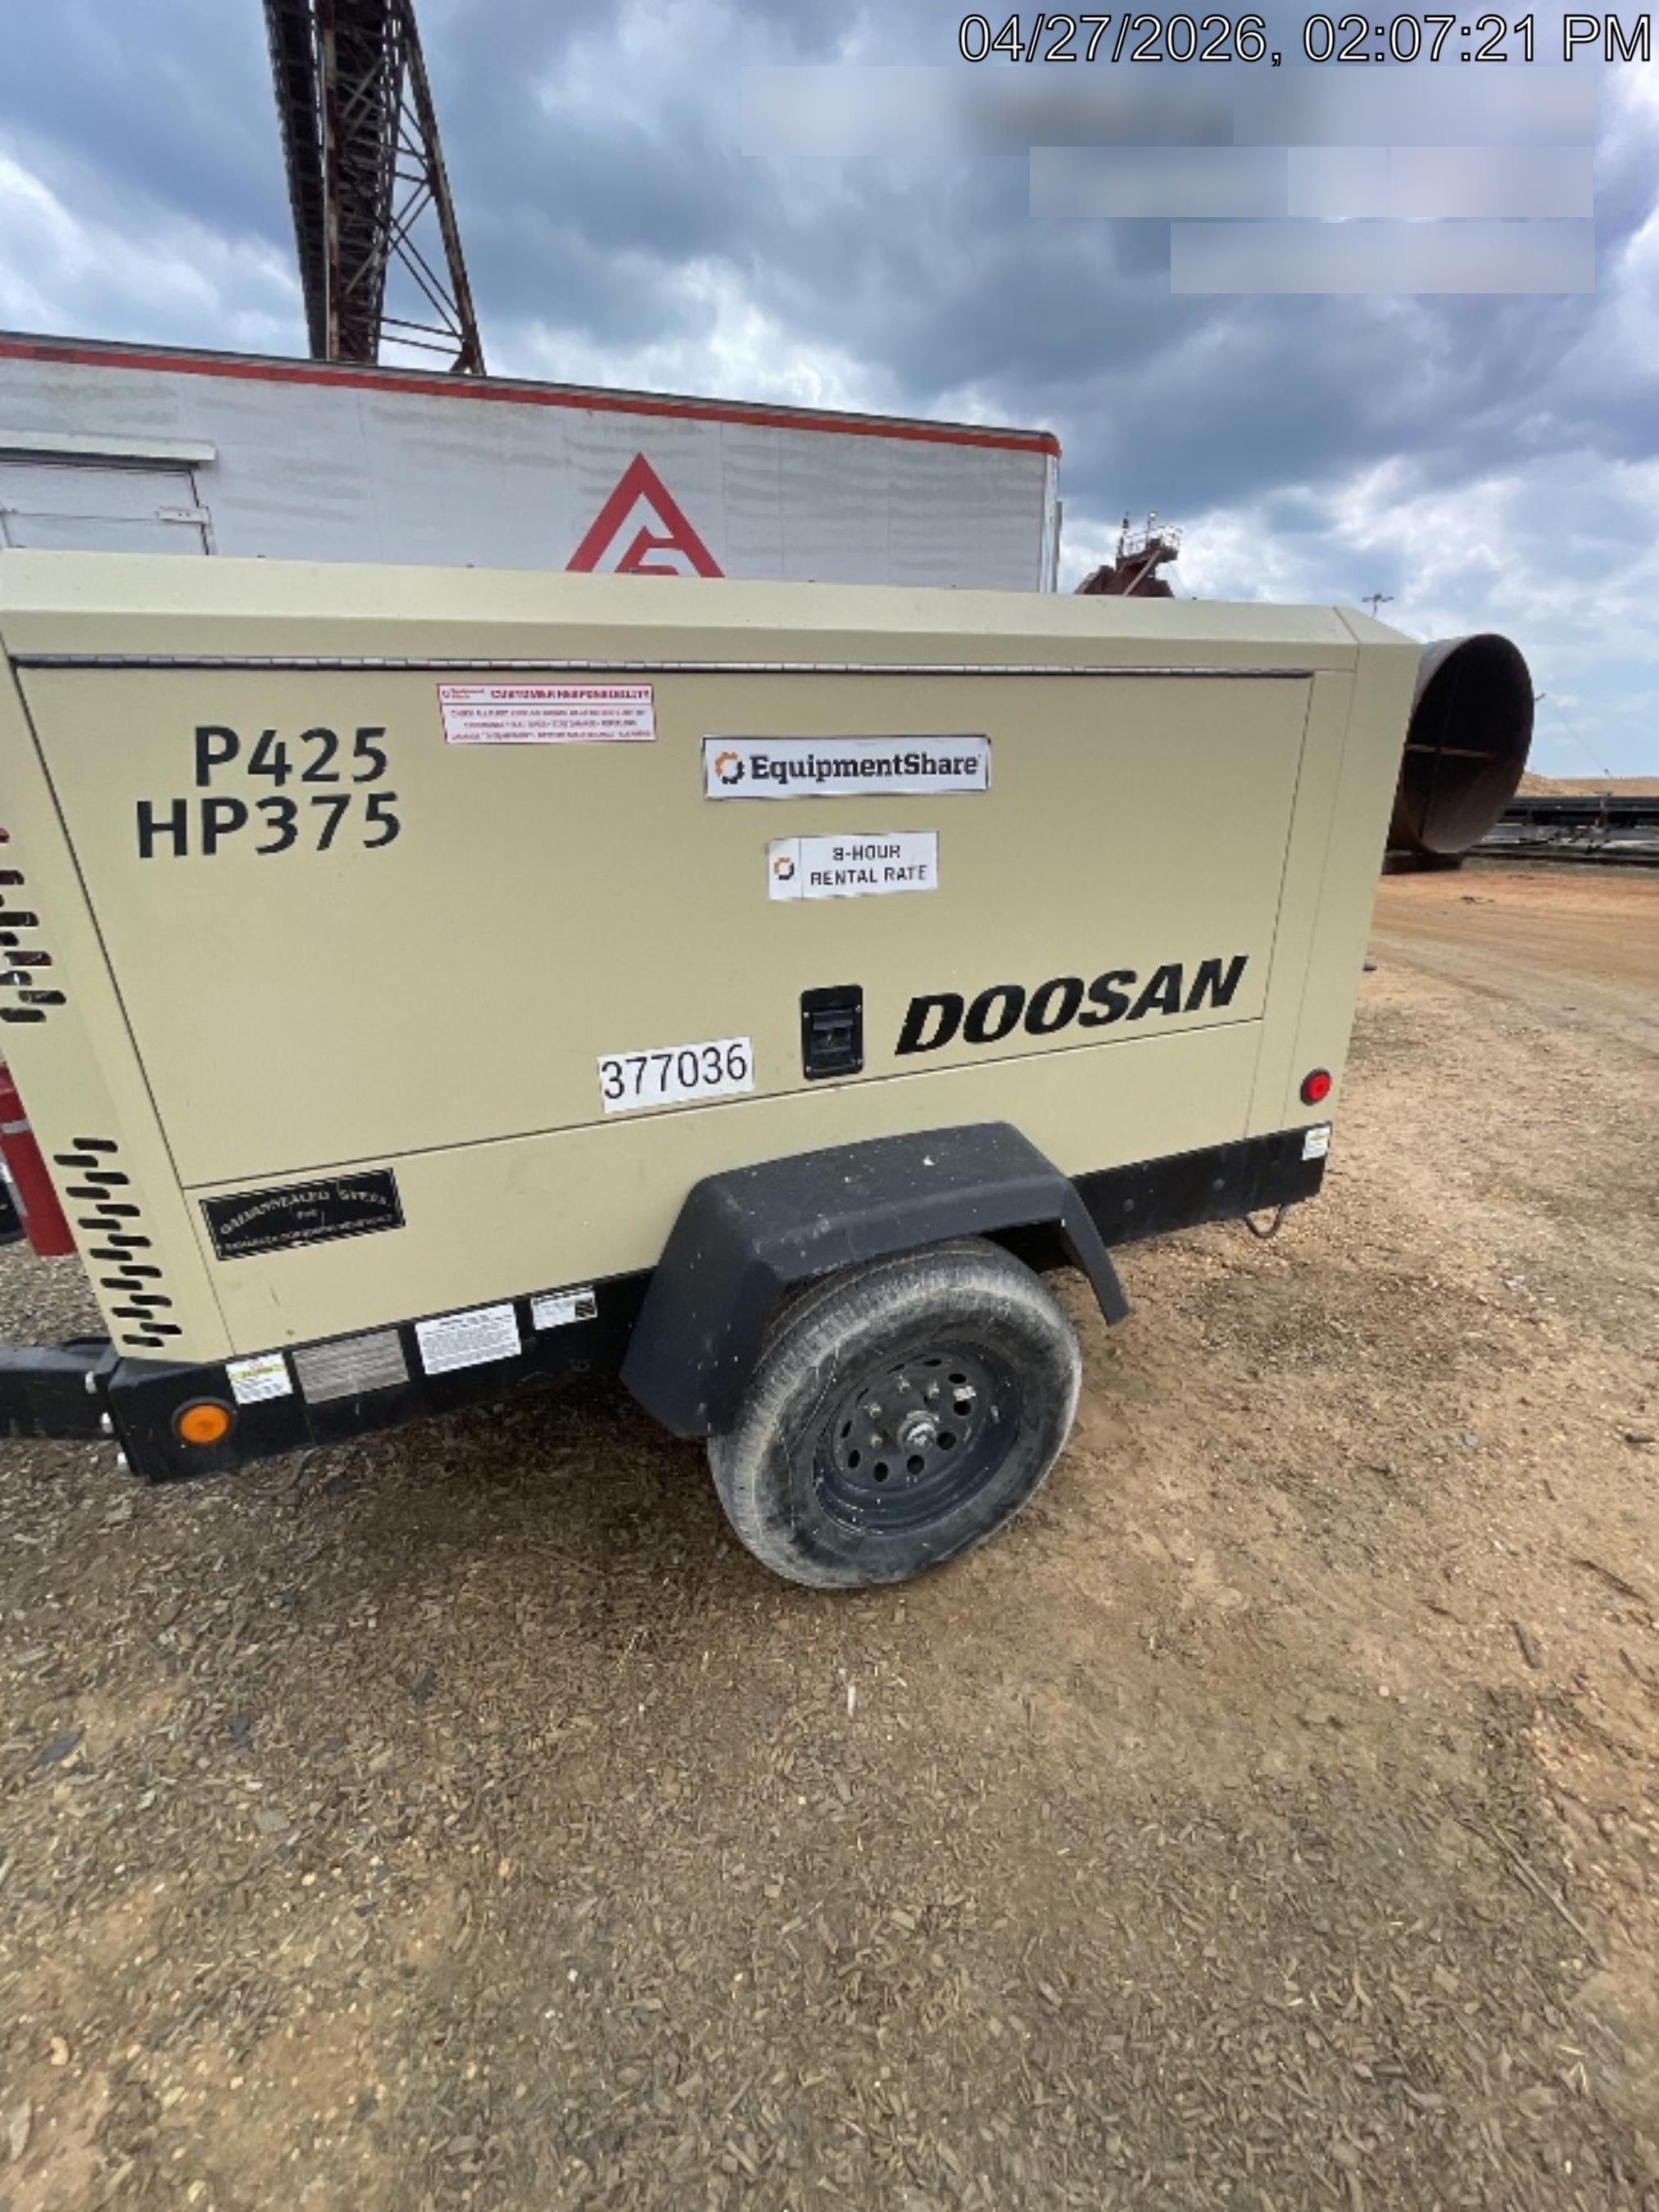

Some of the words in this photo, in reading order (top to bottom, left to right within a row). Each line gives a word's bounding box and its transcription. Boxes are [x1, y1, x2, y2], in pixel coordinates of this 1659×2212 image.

[195, 726, 387, 787] P425
[749, 752, 979, 785] EquipmentShare
[136, 791, 401, 859] HP375
[832, 844, 901, 861] 8-HOUR
[809, 868, 878, 886] RENTAL
[884, 864, 928, 882] RATE
[894, 955, 1249, 1056] DOOSAN
[601, 1044, 746, 1099] 377036
